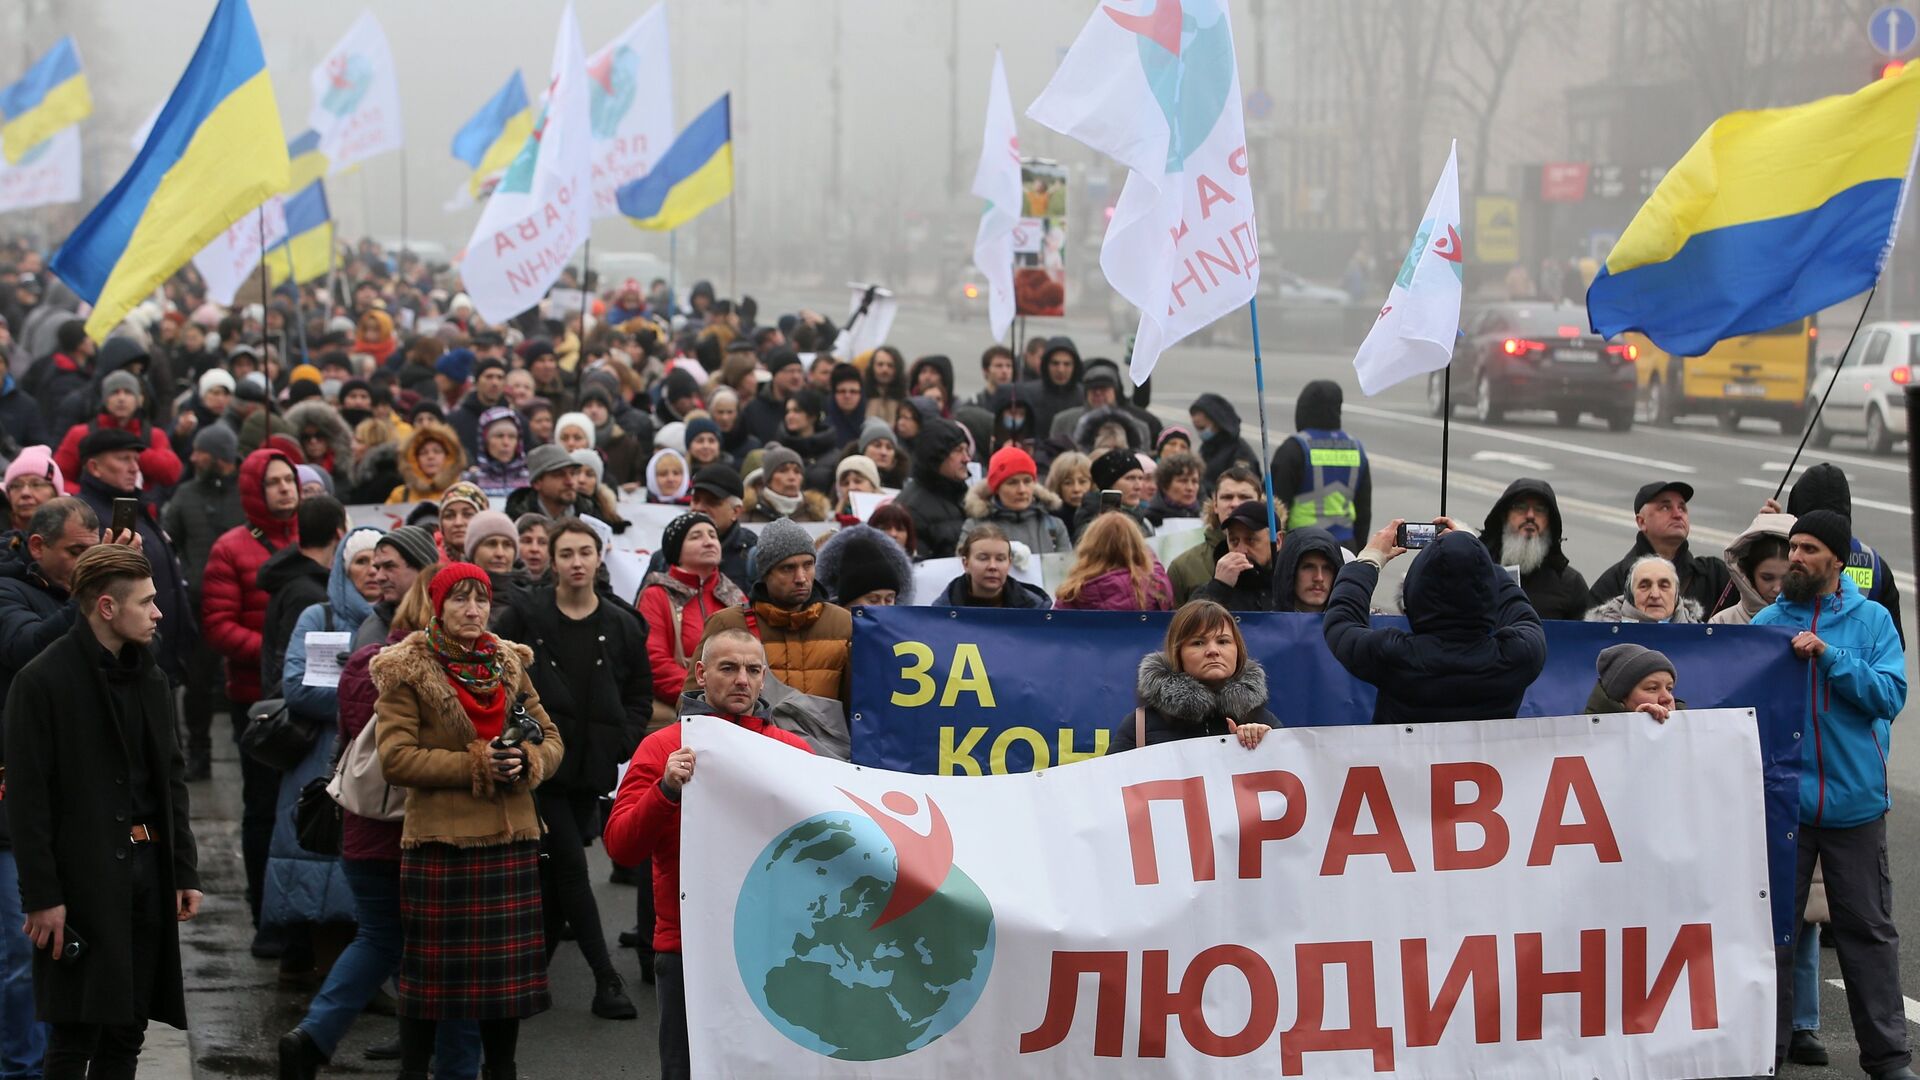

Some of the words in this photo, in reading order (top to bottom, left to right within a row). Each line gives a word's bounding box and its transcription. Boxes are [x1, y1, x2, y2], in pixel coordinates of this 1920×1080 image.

[890, 640, 997, 708] ЗА
[1121, 756, 1623, 885] ПРАВА
[1019, 923, 1719, 1076] ЛЮДИНИ
